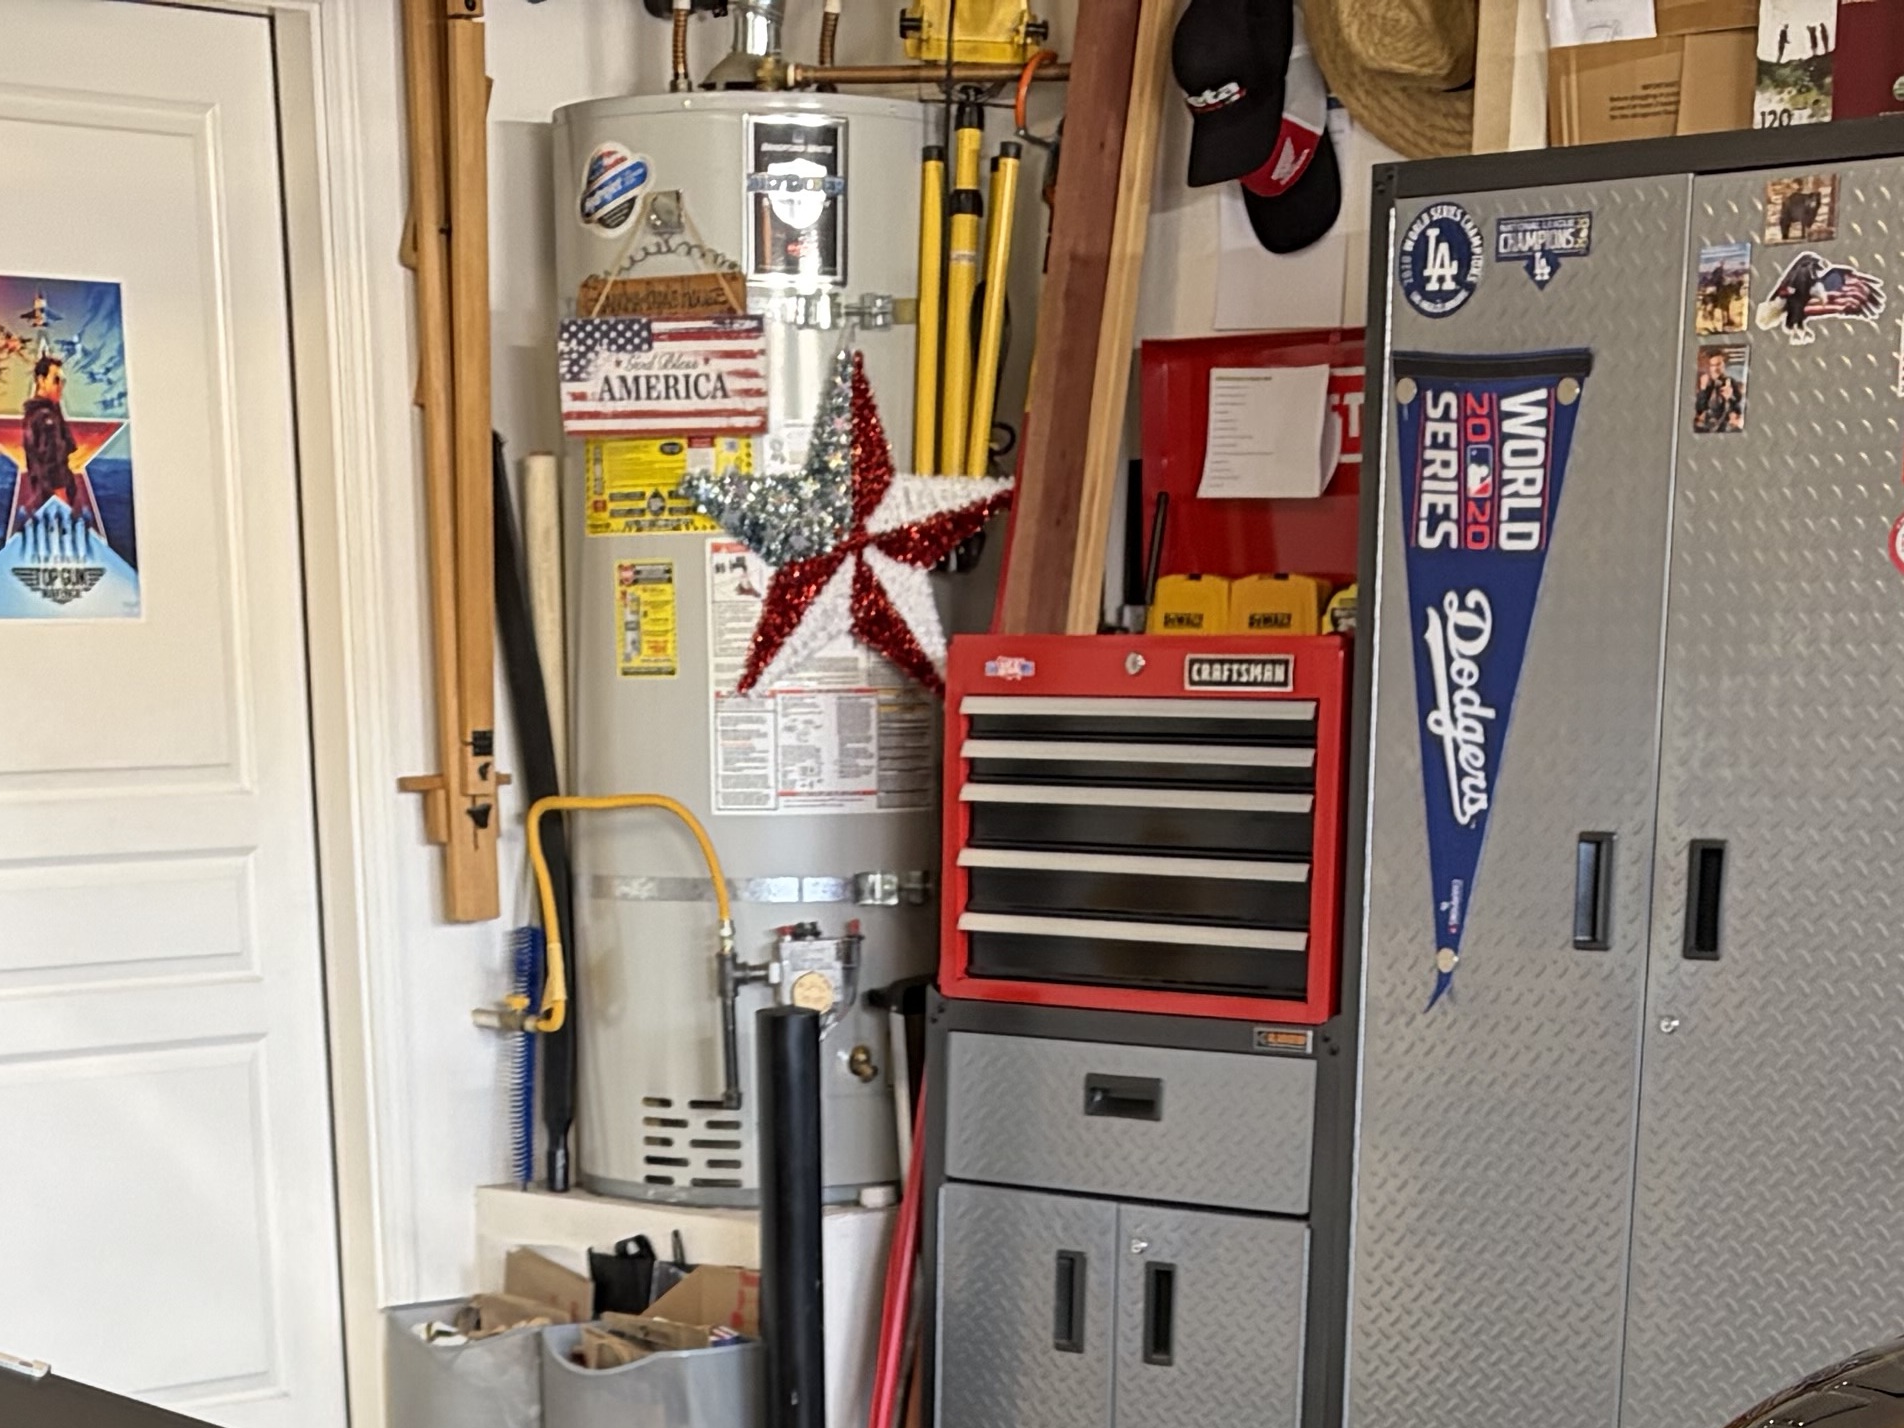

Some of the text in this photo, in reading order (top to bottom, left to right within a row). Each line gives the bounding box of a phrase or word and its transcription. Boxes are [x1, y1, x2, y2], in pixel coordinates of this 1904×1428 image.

[1760, 108, 1791, 128] 120
[1423, 227, 1459, 291] LA
[599, 372, 731, 401] AMERICA
[1418, 389, 1459, 550] SERIES
[1500, 387, 1549, 551] WORLD
[1191, 662, 1286, 682] CRAFTSMAN
[1425, 589, 1495, 827] Dodgers
